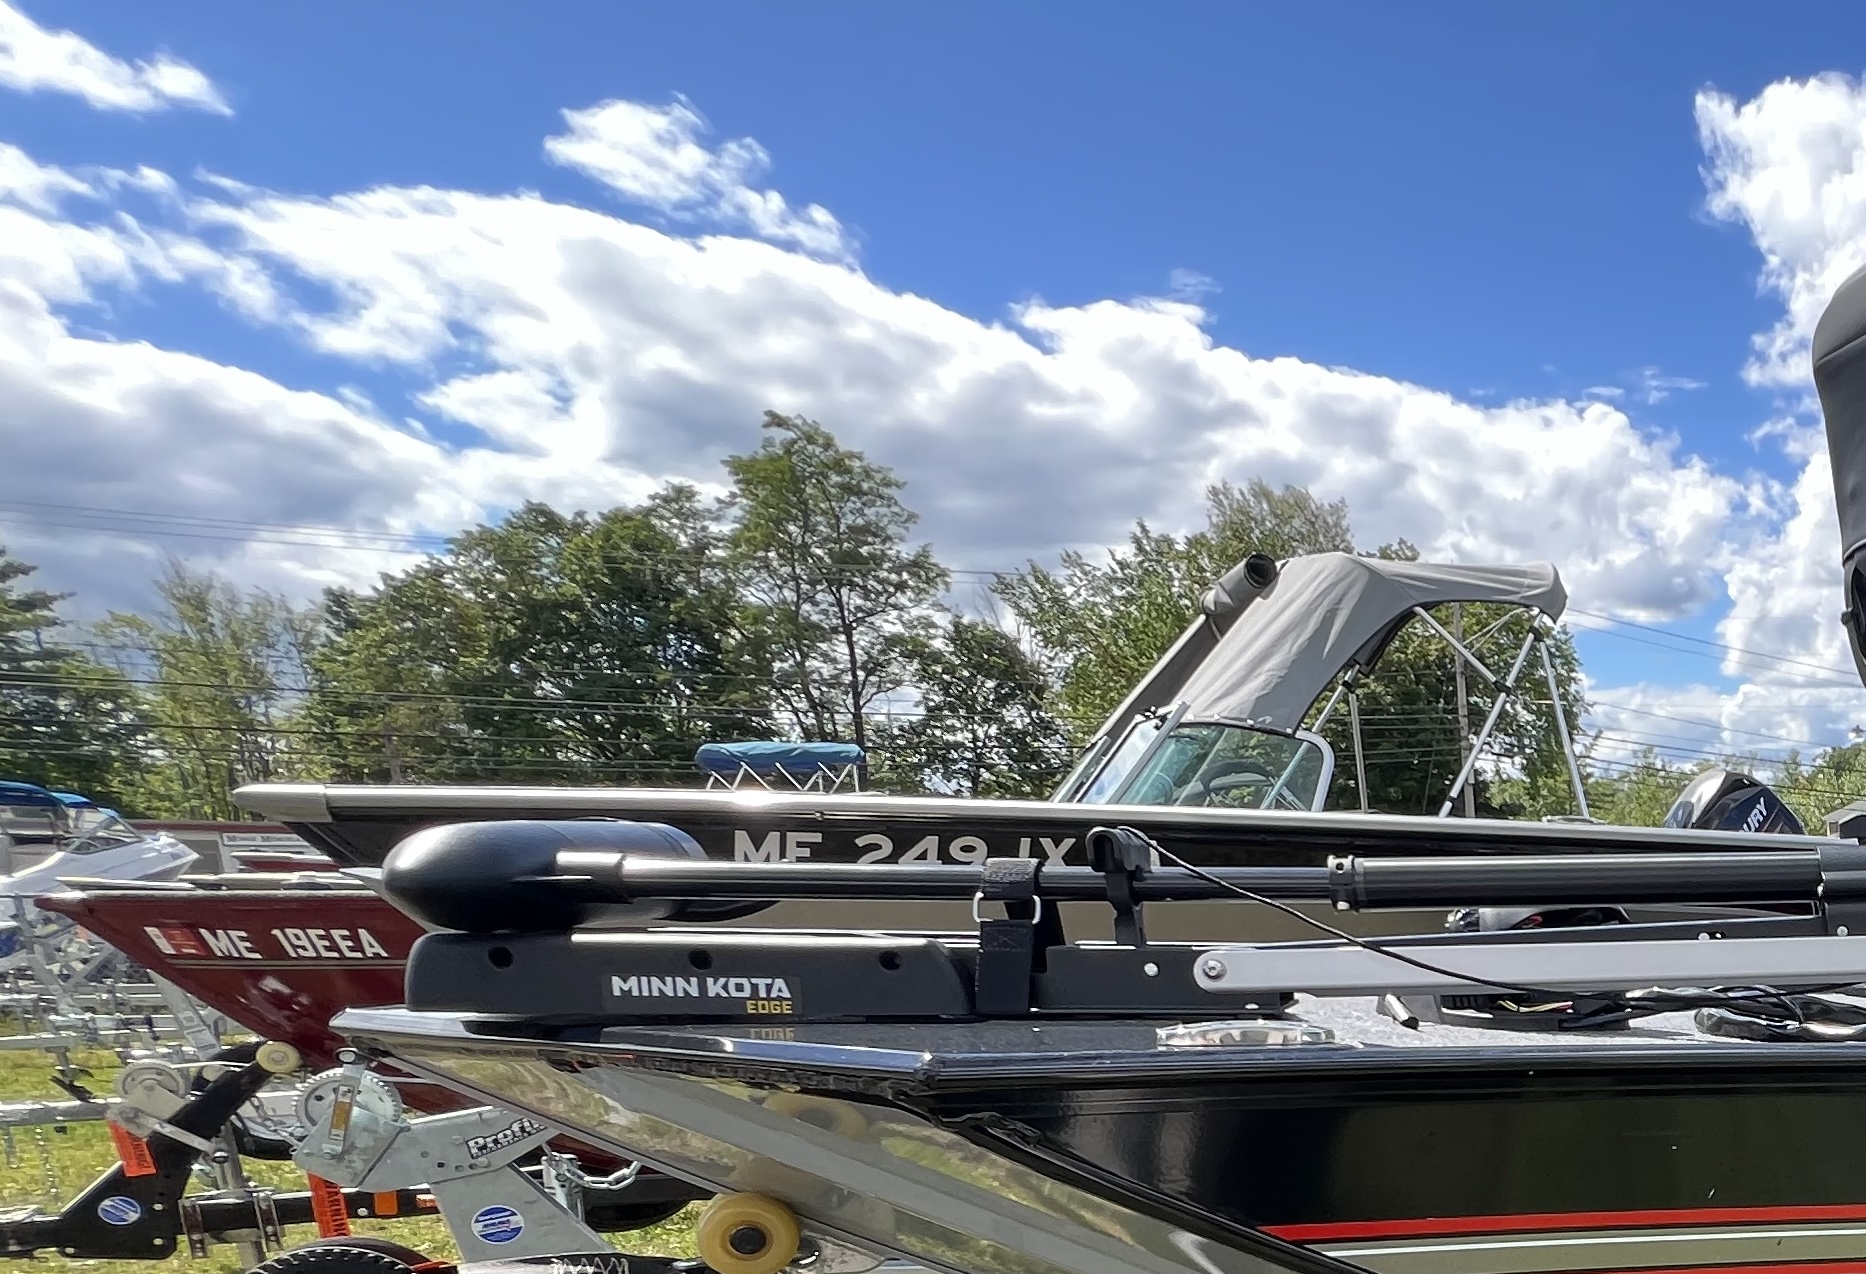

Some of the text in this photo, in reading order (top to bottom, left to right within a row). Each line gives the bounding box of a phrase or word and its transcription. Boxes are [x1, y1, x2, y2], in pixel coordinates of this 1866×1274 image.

[198, 928, 390, 959] ME 19EEA
[611, 976, 792, 998] MINN KOTA
[746, 1000, 793, 1014] EDGE
